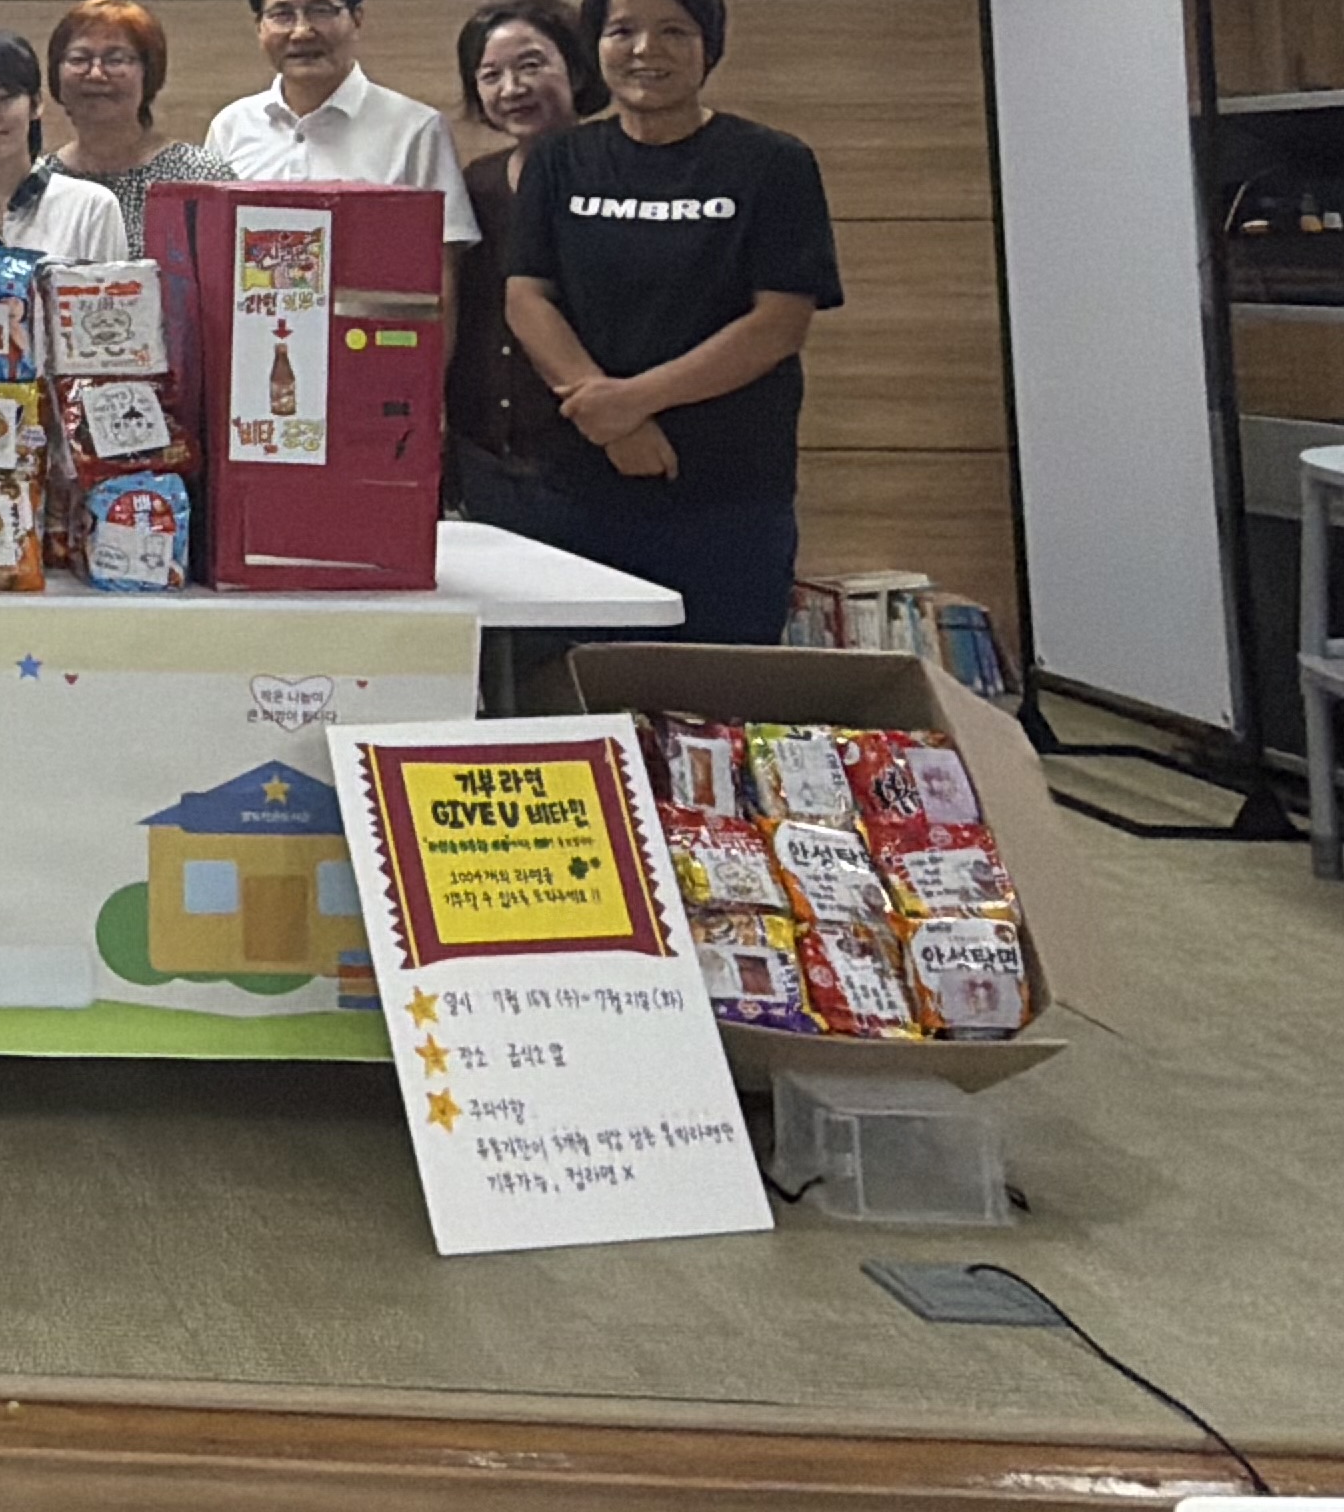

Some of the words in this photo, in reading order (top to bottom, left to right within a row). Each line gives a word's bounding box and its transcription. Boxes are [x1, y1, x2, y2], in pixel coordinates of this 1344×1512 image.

[569, 195, 736, 221] UMBRO
[453, 768, 496, 798] 기부
[498, 767, 547, 798] 라면
[524, 799, 590, 828] 비타민
[458, 1046, 488, 1070] 장소
[507, 1043, 545, 1068] 급식소
[469, 1098, 526, 1125] 주의사항
